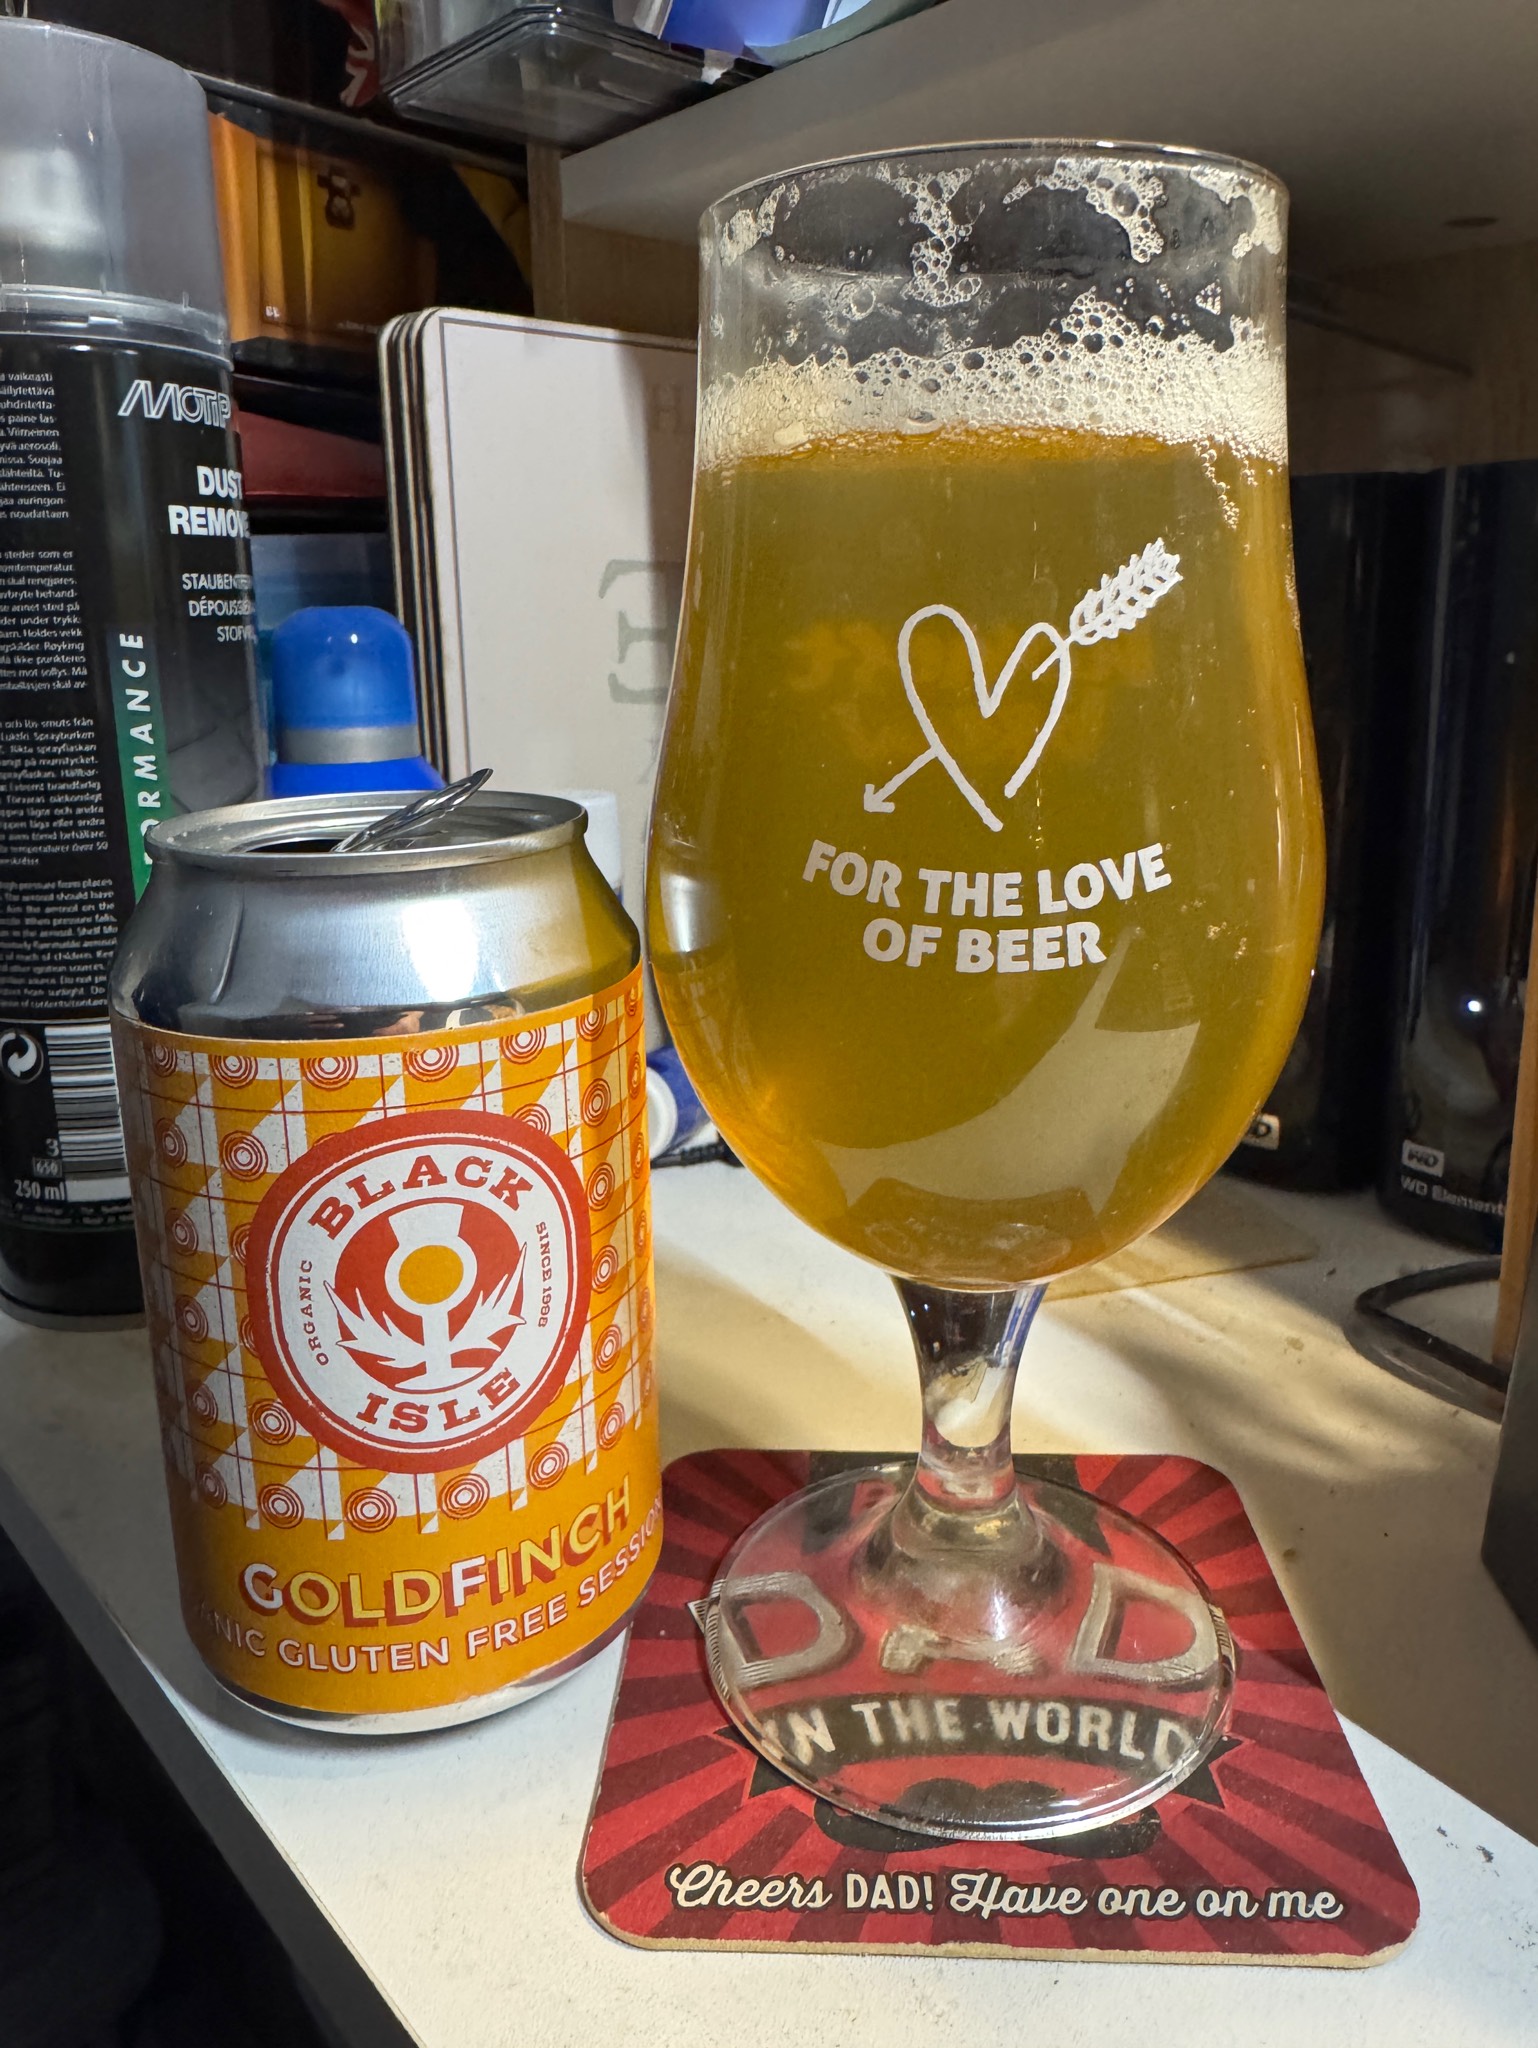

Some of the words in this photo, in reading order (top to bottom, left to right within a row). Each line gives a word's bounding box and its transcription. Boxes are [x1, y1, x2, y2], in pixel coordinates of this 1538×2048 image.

[117, 379, 231, 428] MOTIP
[802, 839, 902, 908] FOR
[918, 868, 1024, 917] THE
[1037, 842, 1173, 914] LOVE
[862, 918, 942, 968] OF
[955, 921, 1107, 974] BEER
[14, 1179, 41, 1199] 250
[44, 1181, 65, 1201] ml
[307, 1154, 535, 1241] BLACK
[536, 1221, 552, 1283] SINCE
[299, 1260, 329, 1366] ORGANIC
[356, 1366, 521, 1434] ISLE
[240, 1474, 630, 1624] GOLDFINCH
[277, 1636, 450, 1675] GLUTEN
[466, 1593, 569, 1659] FREE
[851, 1700, 966, 1747] THE
[986, 1700, 1198, 1774] WORLD
[669, 1863, 833, 1909] Cheers
[846, 1872, 934, 1911] DAD!
[949, 1871, 1088, 1920] Have
[1097, 1887, 1187, 1917] one
[1195, 1888, 1260, 1919] on
[1267, 1887, 1345, 1919] me
